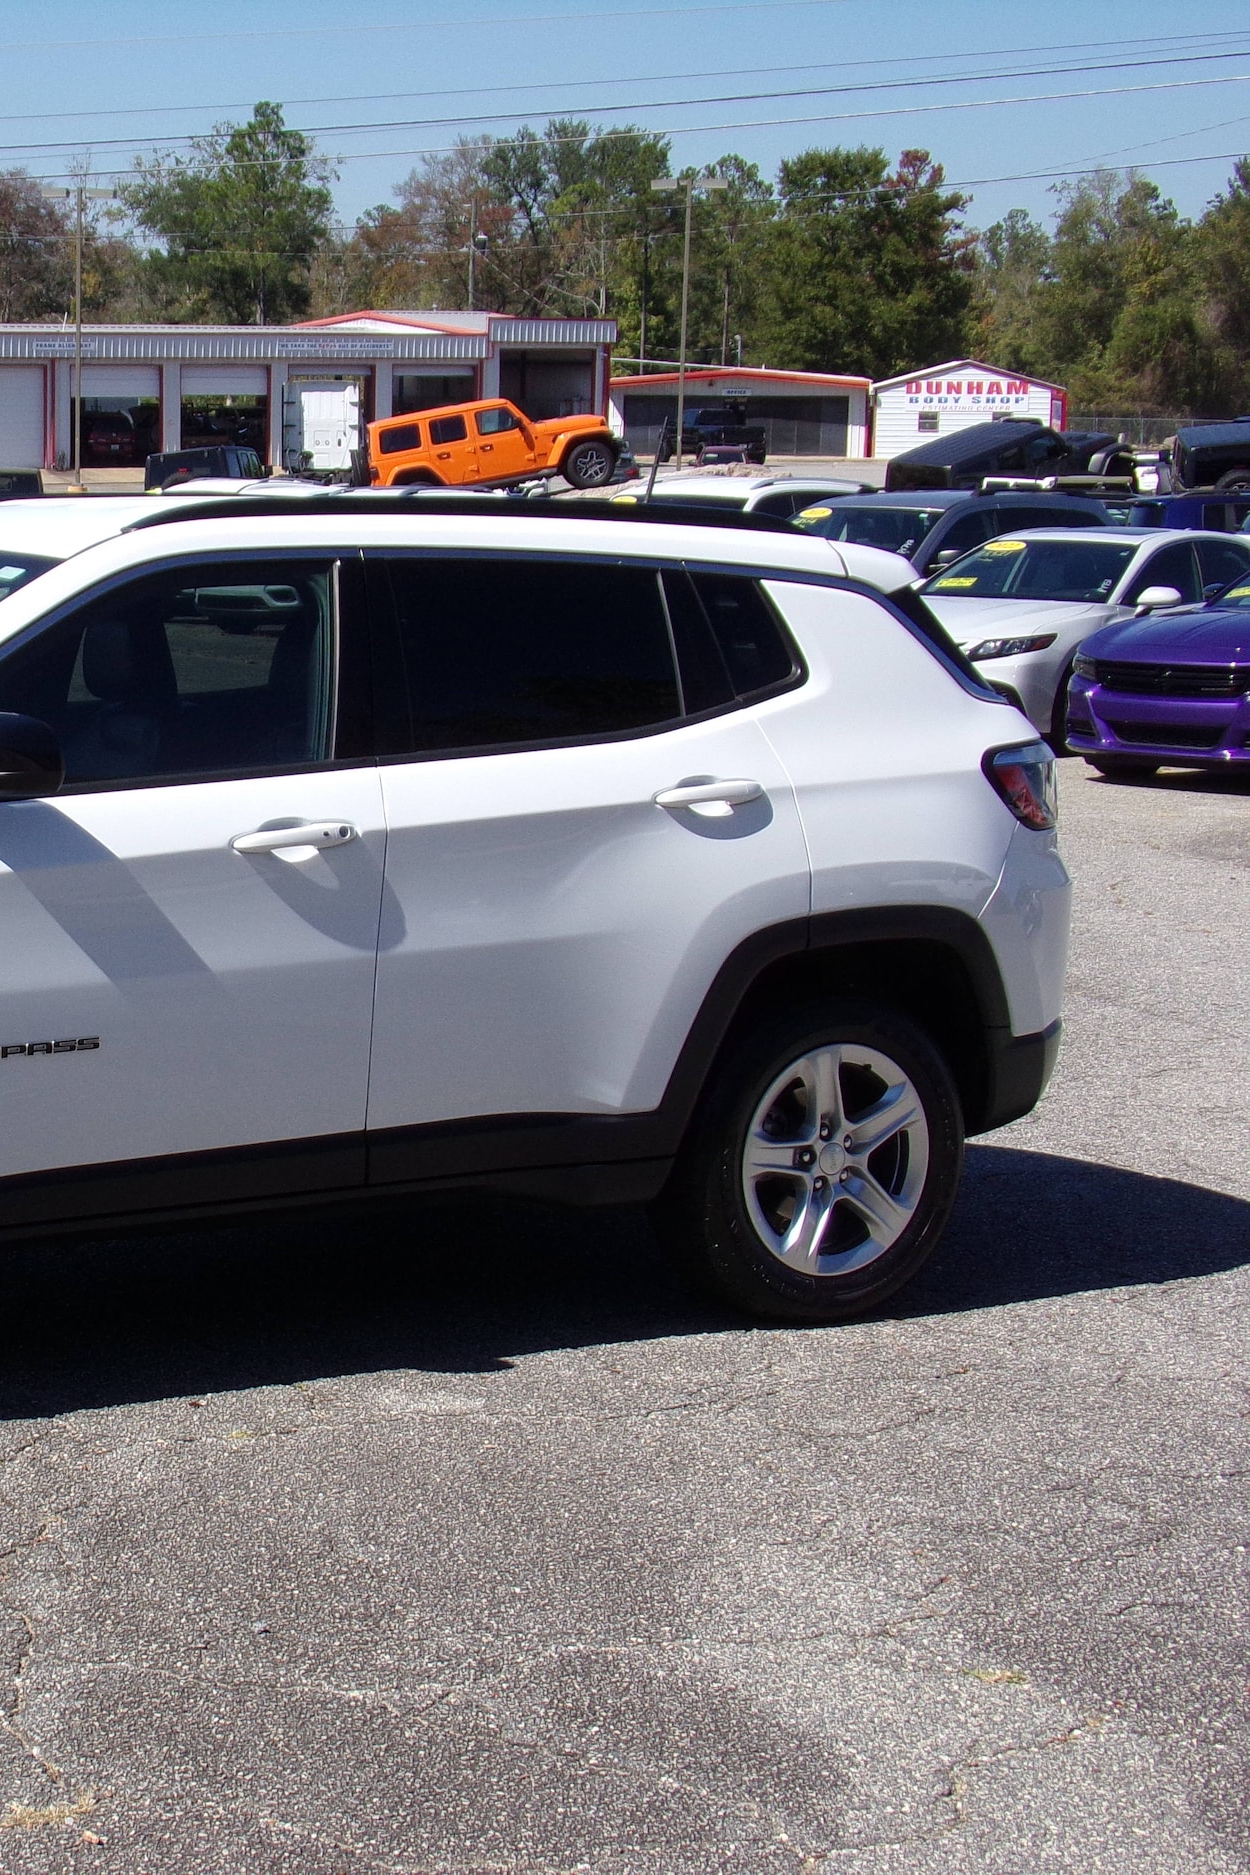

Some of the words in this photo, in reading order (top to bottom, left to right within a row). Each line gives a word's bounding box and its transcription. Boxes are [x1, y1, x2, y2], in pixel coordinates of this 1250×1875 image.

[906, 380, 1029, 395] DUNHAM
[909, 396, 962, 404] BODY
[971, 396, 1025, 404] SHOP
